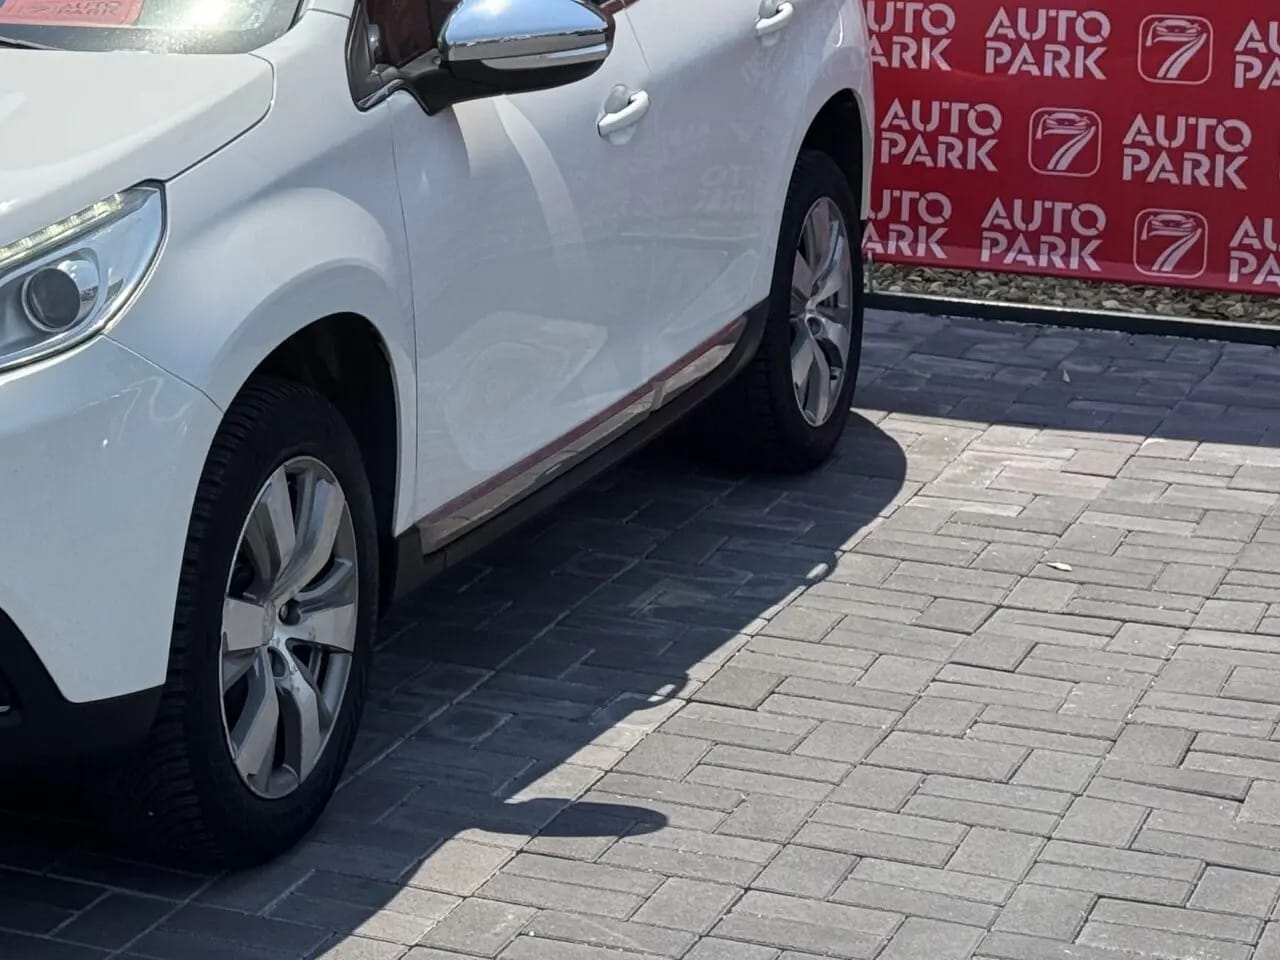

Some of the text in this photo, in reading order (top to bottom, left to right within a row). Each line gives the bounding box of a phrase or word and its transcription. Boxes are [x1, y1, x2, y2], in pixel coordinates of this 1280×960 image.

[986, 8, 1111, 45] AUTO
[986, 42, 1107, 81] PARK
[882, 100, 1003, 137] AUTO
[1123, 115, 1253, 153] AUTO
[882, 133, 999, 172] PARK
[1124, 149, 1249, 190] PARK
[982, 199, 1107, 237] AUTO
[981, 232, 1103, 273] PARK
